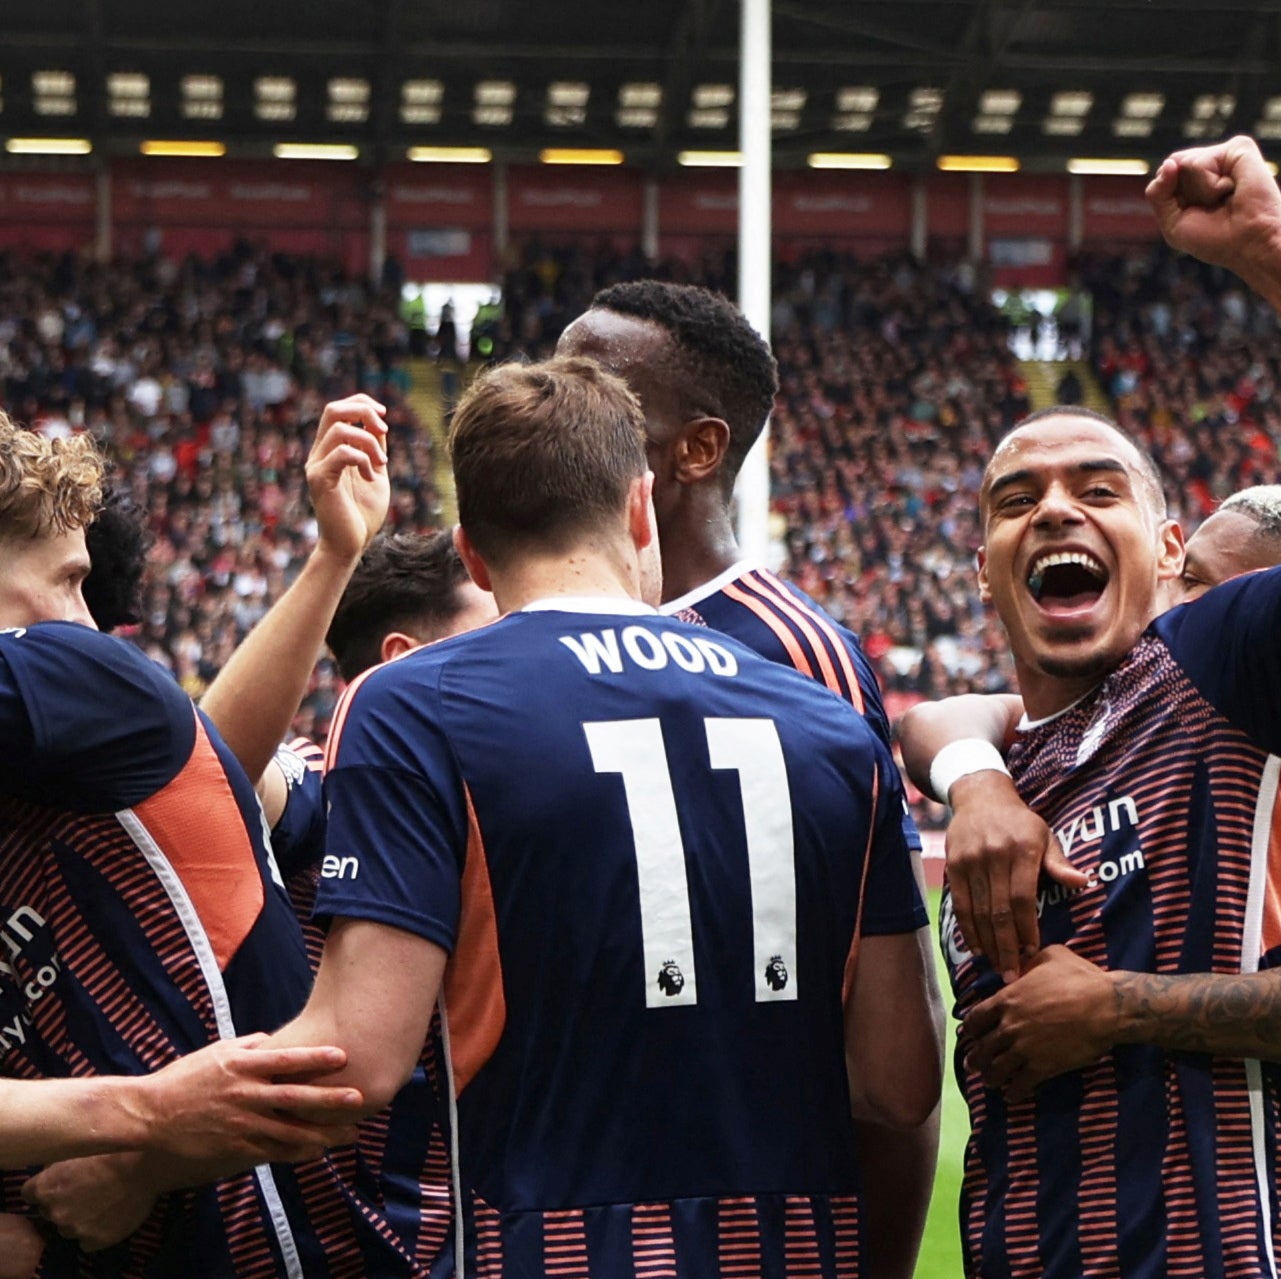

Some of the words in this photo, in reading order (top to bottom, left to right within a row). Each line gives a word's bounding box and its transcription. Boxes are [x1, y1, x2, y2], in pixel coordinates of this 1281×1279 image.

[558, 625, 738, 677] WOOD
[1051, 795, 1140, 858] yun
[321, 854, 359, 880] en
[582, 716, 798, 1008] 11
